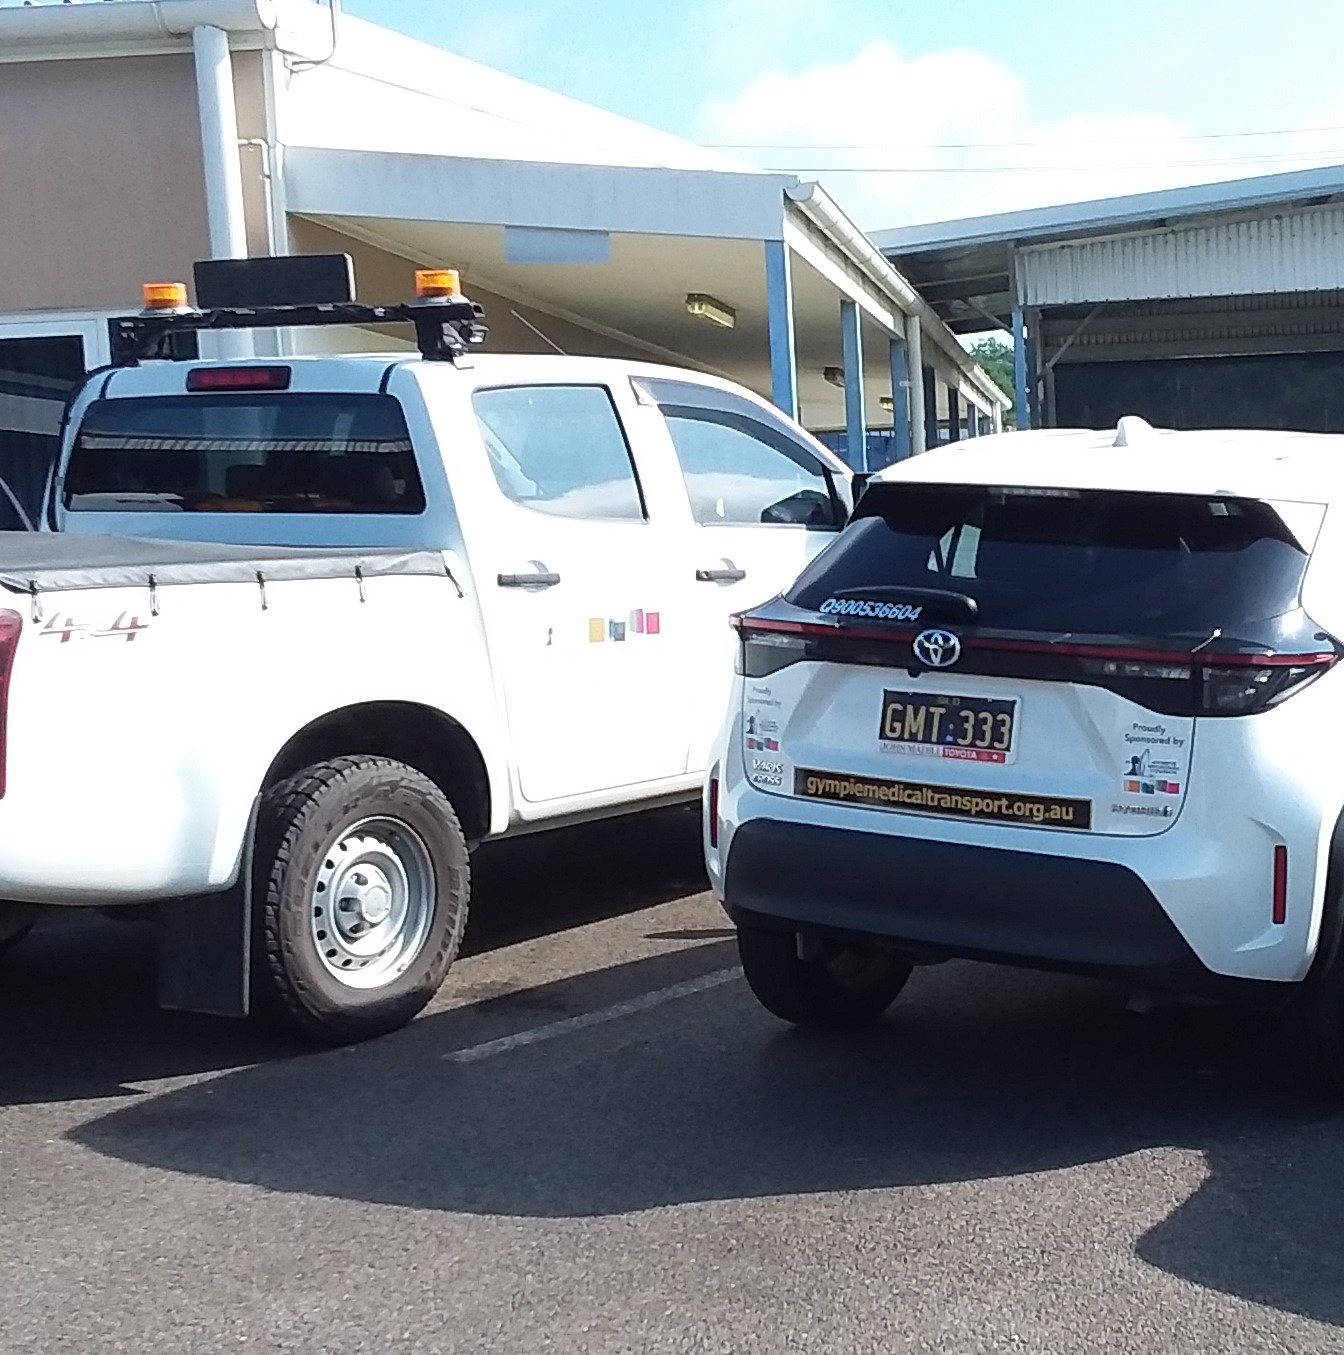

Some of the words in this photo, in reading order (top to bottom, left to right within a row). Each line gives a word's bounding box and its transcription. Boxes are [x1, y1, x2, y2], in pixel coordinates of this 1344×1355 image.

[820, 598, 923, 621] Q900536604
[1132, 722, 1166, 736] Proudly
[1124, 733, 1171, 745] Sponsored
[1173, 737, 1184, 748] by
[944, 748, 978, 760] TOYOTA
[806, 775, 1074, 821] gympiemedicaltransport.org.au
